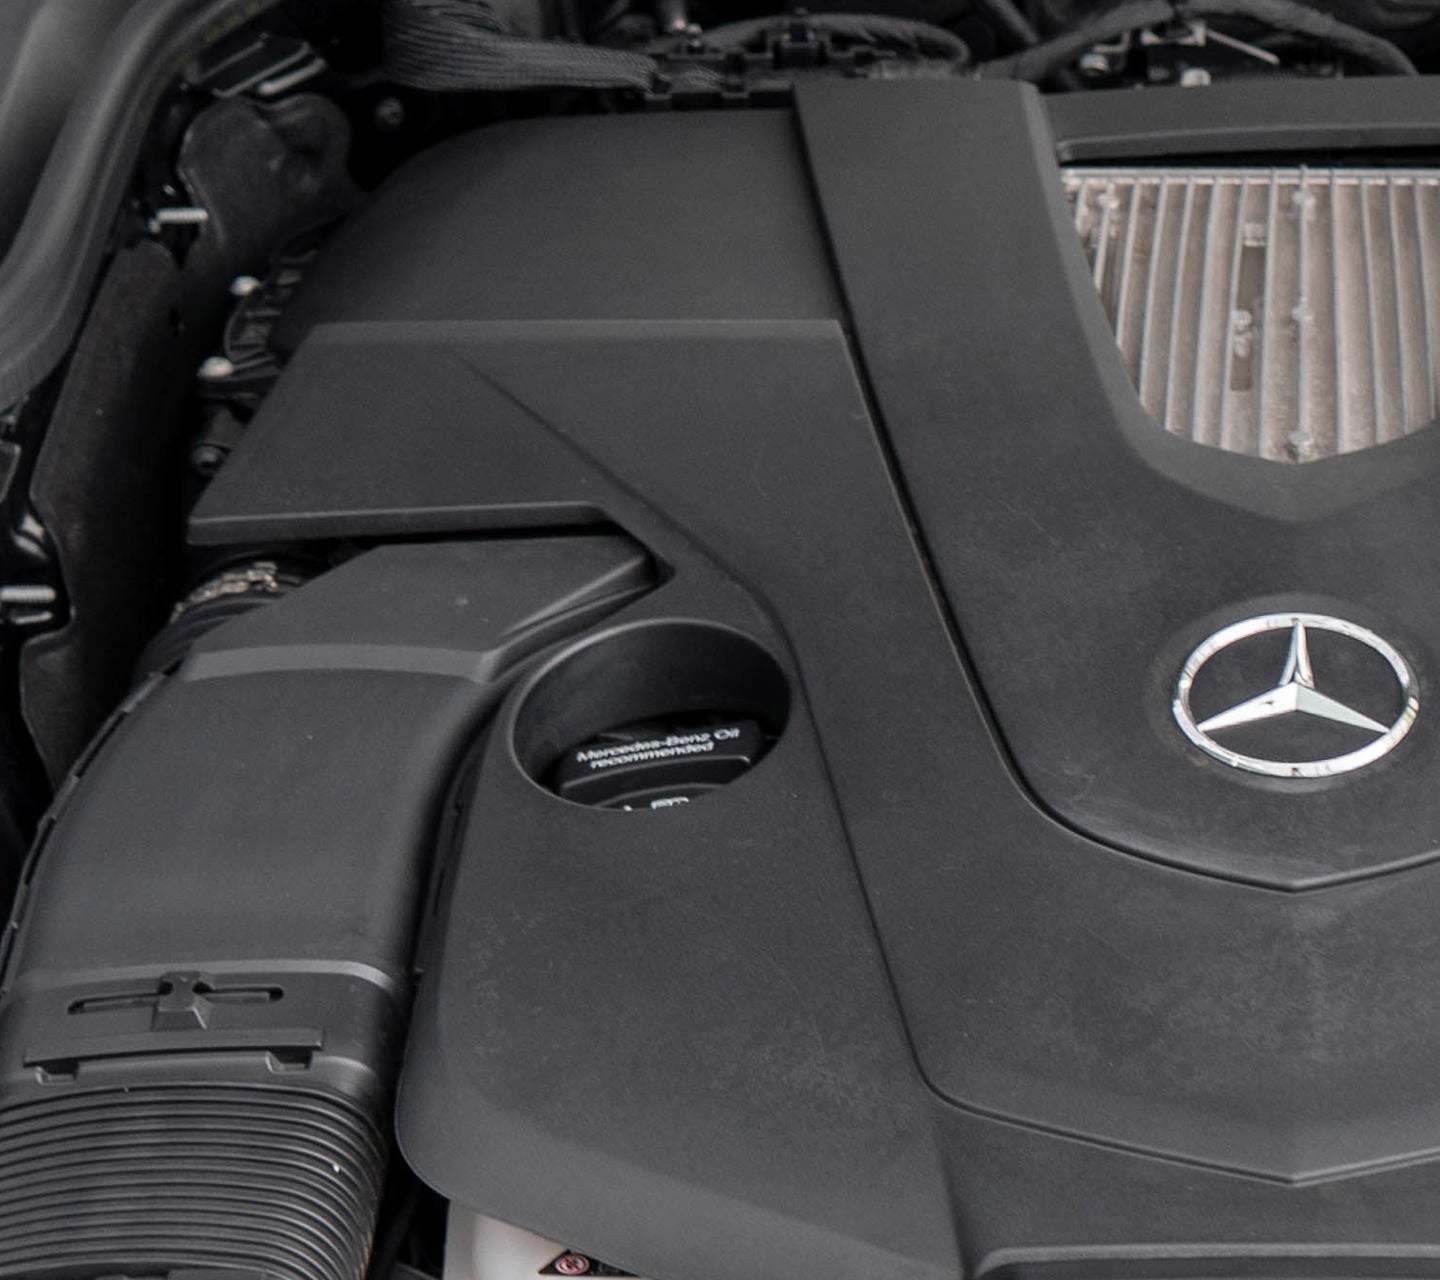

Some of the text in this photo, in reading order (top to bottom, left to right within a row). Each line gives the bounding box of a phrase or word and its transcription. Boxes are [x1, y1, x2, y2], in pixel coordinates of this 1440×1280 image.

[576, 727, 740, 762] Mercedes-Benz Oil
[590, 741, 714, 769] recommended
